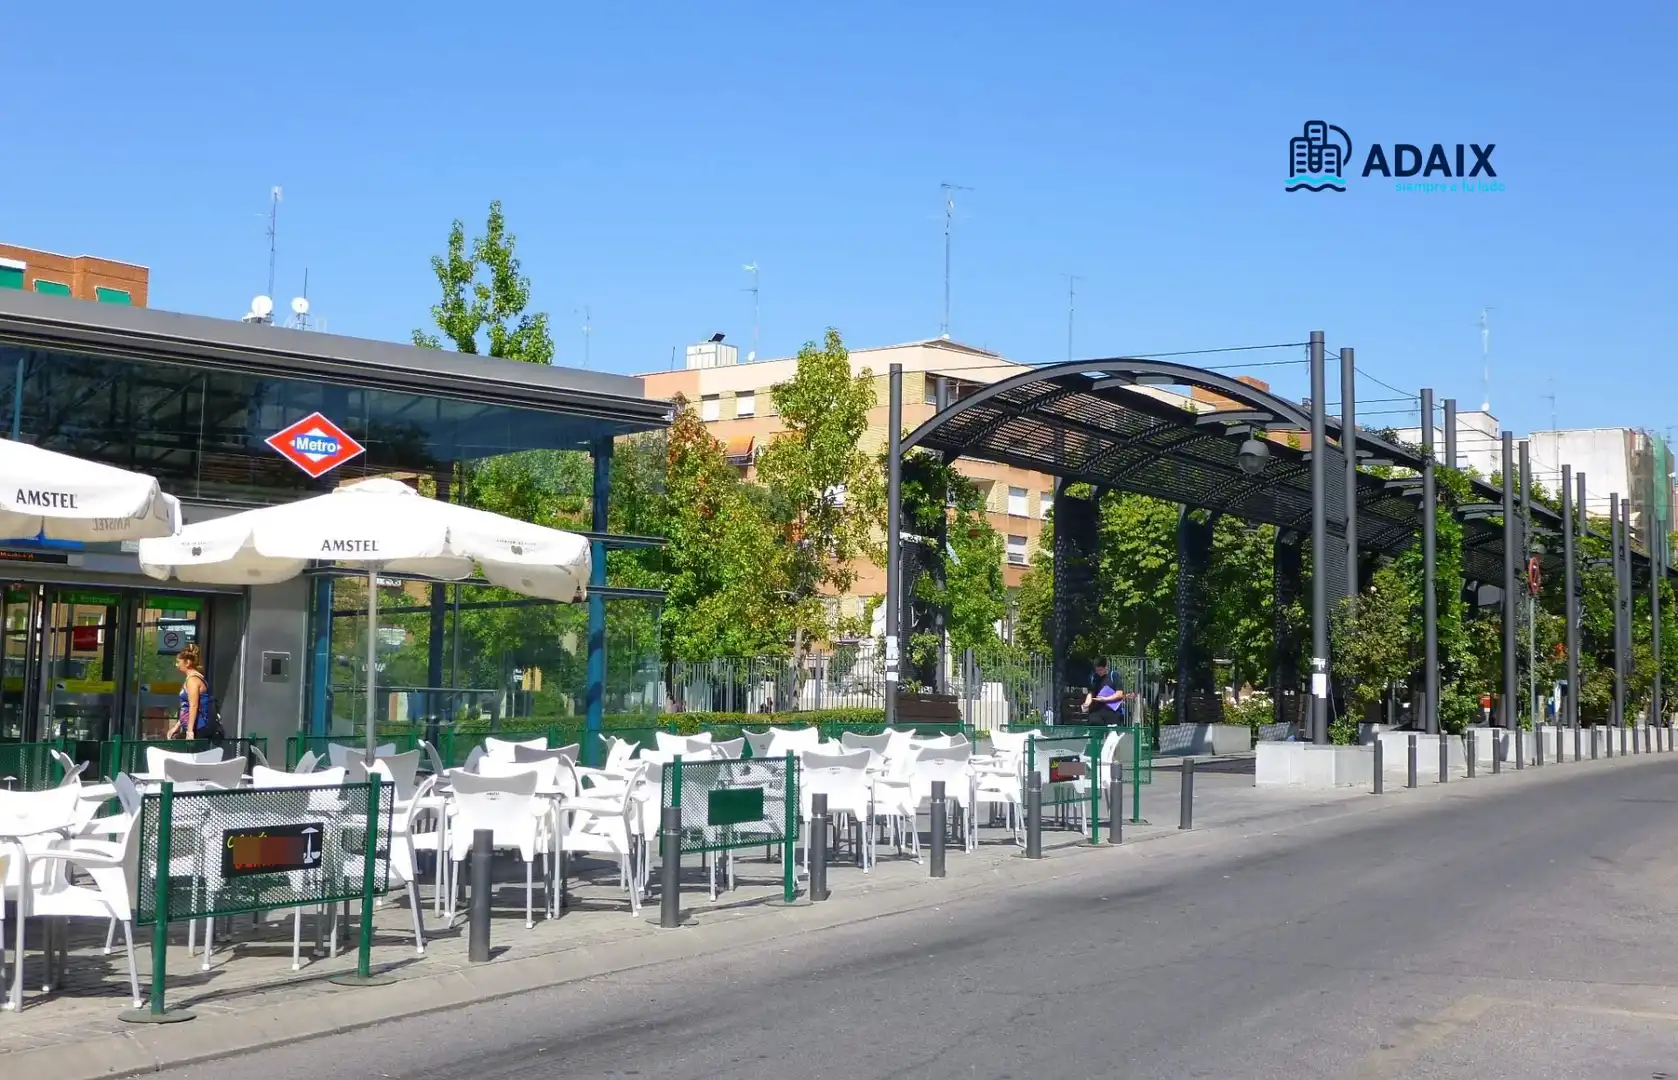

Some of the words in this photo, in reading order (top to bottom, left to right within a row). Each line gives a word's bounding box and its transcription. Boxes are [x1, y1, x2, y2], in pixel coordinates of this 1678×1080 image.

[296, 437, 337, 453] Metro
[16, 489, 78, 509] AMSTEL
[321, 539, 379, 552] AMSTEL
